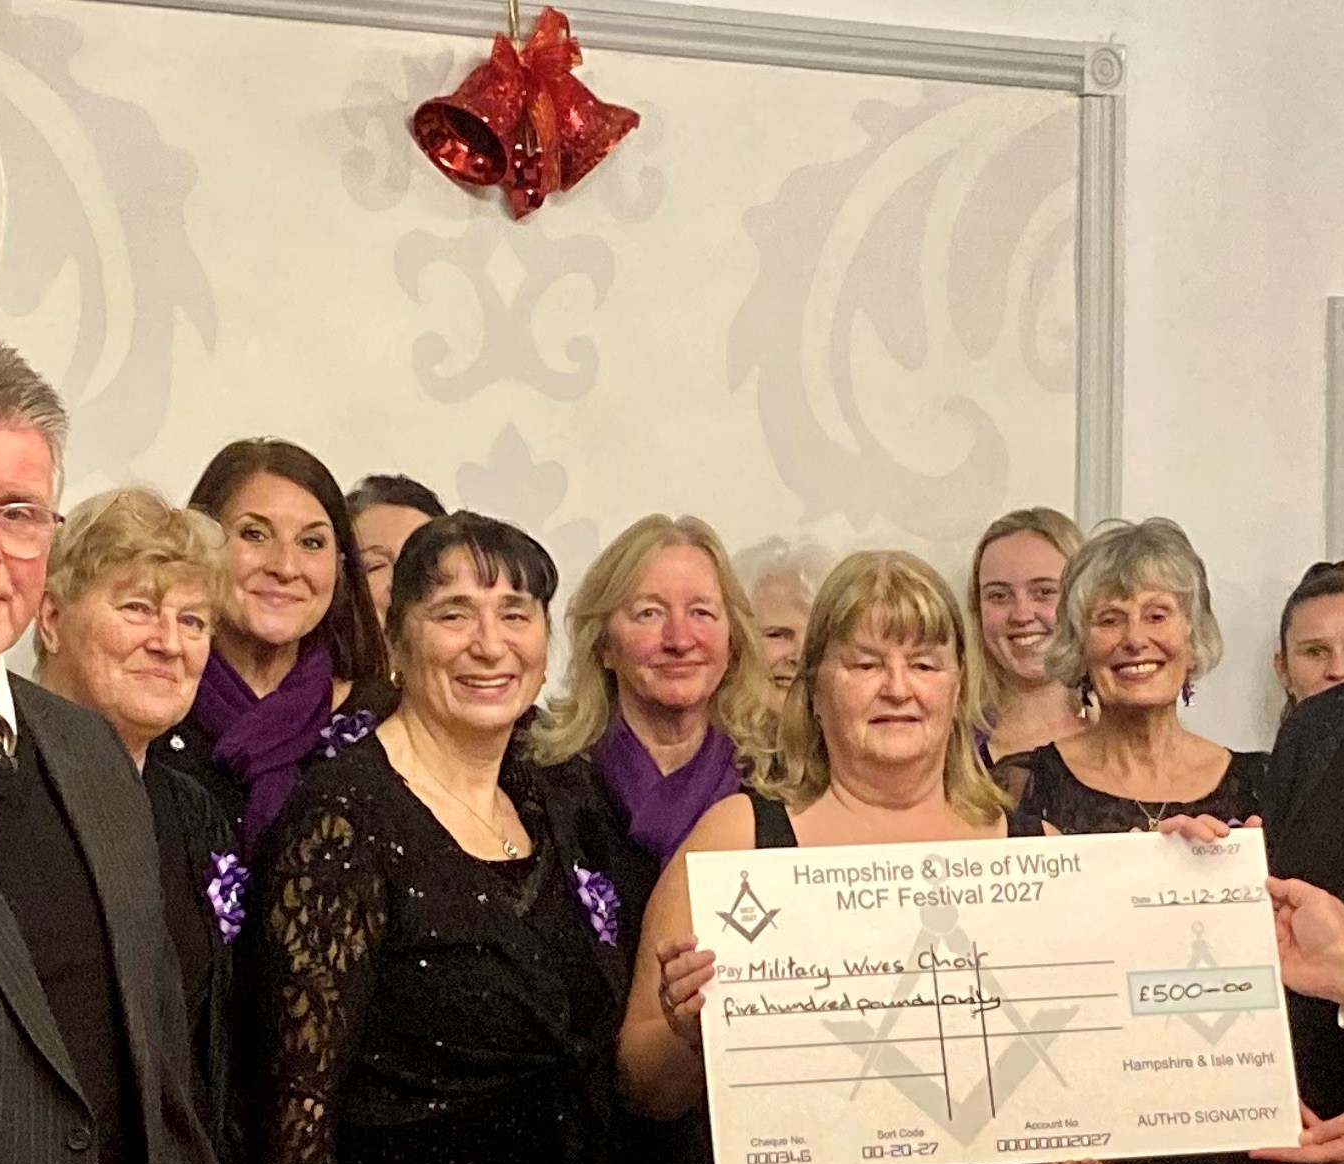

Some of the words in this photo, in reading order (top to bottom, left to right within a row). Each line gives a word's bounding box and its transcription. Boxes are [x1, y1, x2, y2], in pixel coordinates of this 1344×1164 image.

[1191, 843, 1241, 856] 00-20-27
[793, 860, 914, 887] Hampshire
[922, 859, 938, 880] &
[945, 857, 983, 878] Isle
[990, 855, 1012, 876] of
[1016, 853, 1081, 879] Wight
[836, 888, 889, 911] MCF
[898, 883, 984, 908] Festival
[990, 881, 1044, 903] 2027
[717, 965, 743, 979] Pay
[749, 955, 831, 989] Military
[843, 956, 904, 976] Wives
[918, 946, 988, 970] Choir
[724, 996, 759, 1026] five
[760, 992, 851, 1014] hundred
[1122, 1055, 1193, 1072] Hampshire
[1197, 1054, 1208, 1067] &
[1211, 1053, 1234, 1067] Isle
[1236, 1051, 1275, 1067] Wight
[1025, 1120, 1063, 1130] Account
[1137, 1111, 1191, 1128] AUTH'D
[1194, 1106, 1278, 1124] SIGNATORY
[750, 1137, 788, 1148] Cheque
[877, 1129, 897, 1140] Sort
[899, 1128, 925, 1138] Code
[862, 1142, 939, 1159] 00-20-27
